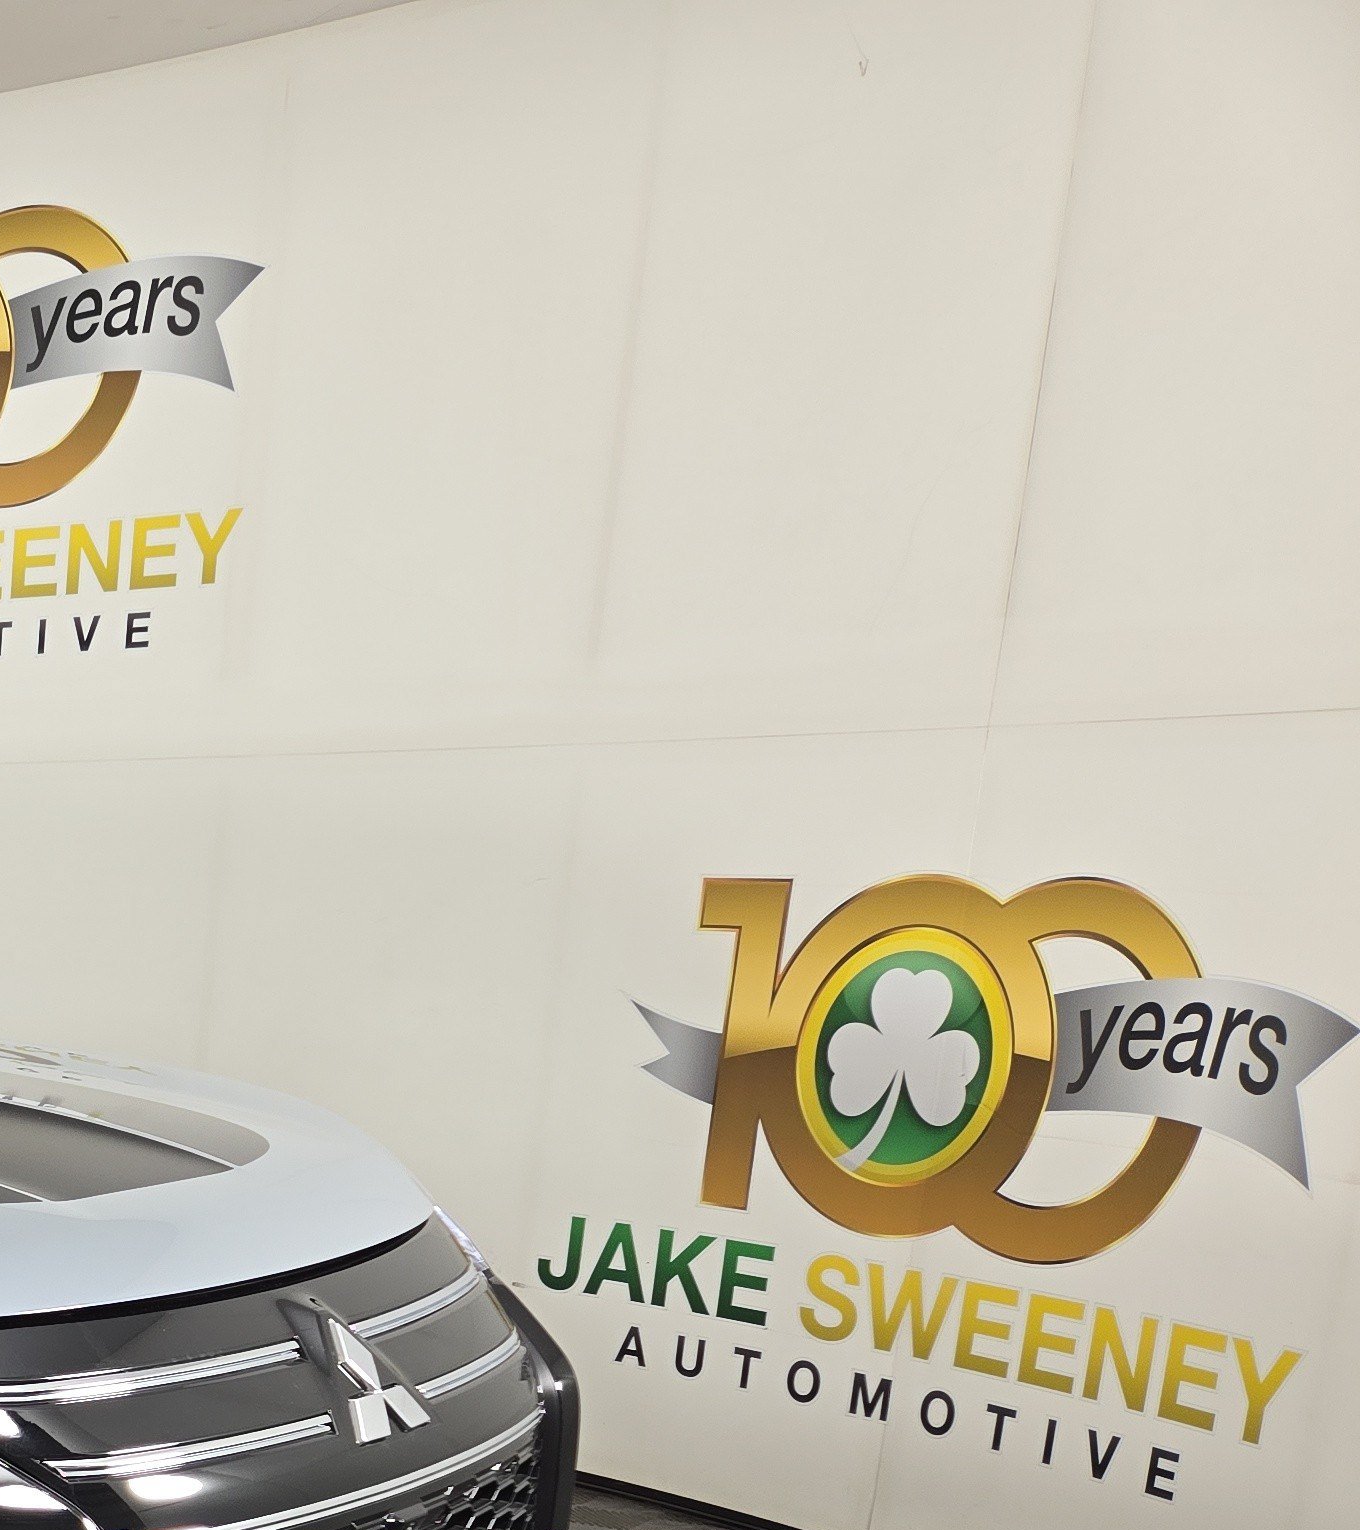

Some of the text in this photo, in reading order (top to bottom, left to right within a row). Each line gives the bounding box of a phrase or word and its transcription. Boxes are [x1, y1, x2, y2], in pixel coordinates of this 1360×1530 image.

[24, 274, 205, 373] years
[699, 873, 1289, 1266] 100 years
[536, 1216, 1305, 1447] JAKE SWEENEY
[613, 1325, 1182, 1503] AUTOMOTIVE
